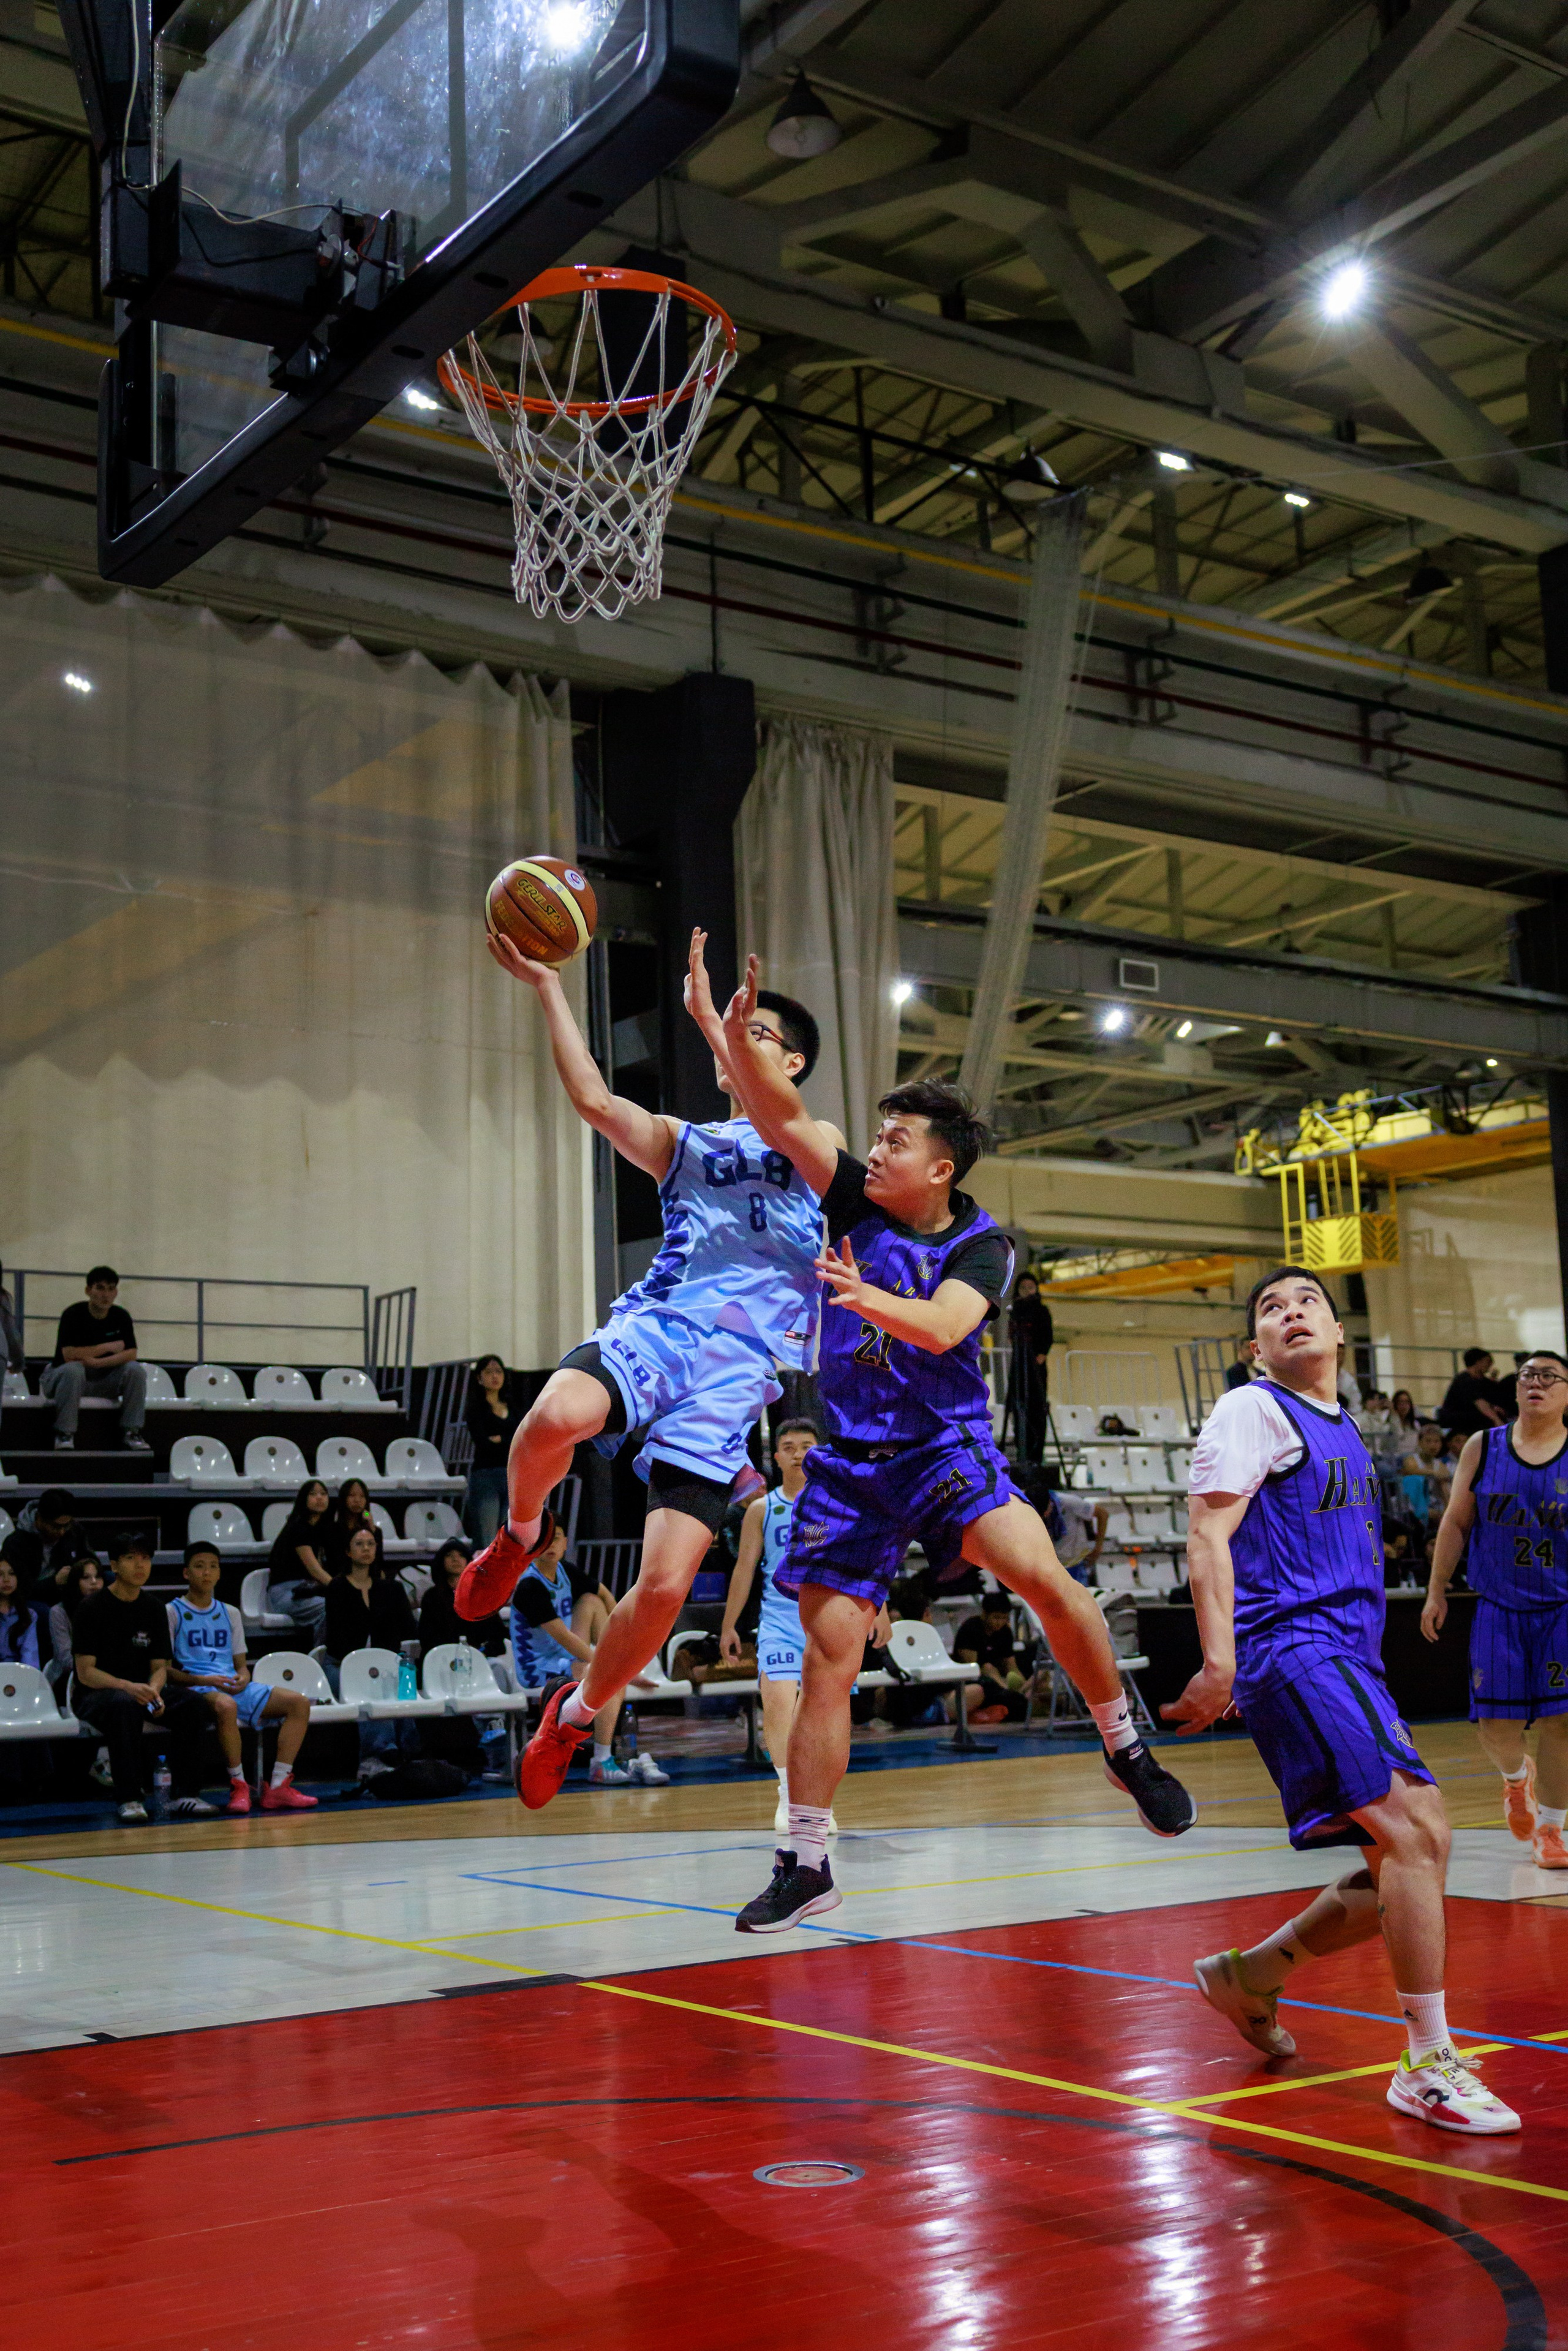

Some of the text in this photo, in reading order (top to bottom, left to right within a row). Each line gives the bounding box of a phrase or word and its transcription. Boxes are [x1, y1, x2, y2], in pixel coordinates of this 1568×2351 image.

[702, 1138, 794, 1191] GLB
[748, 1192, 767, 1232] 8
[854, 1322, 892, 1372] 21
[929, 1468, 973, 1504] 21
[1514, 1536, 1554, 1568] 24
[188, 1628, 228, 1648] GLB
[766, 1651, 794, 1666] GLB
[1547, 1661, 1568, 1689] 2
